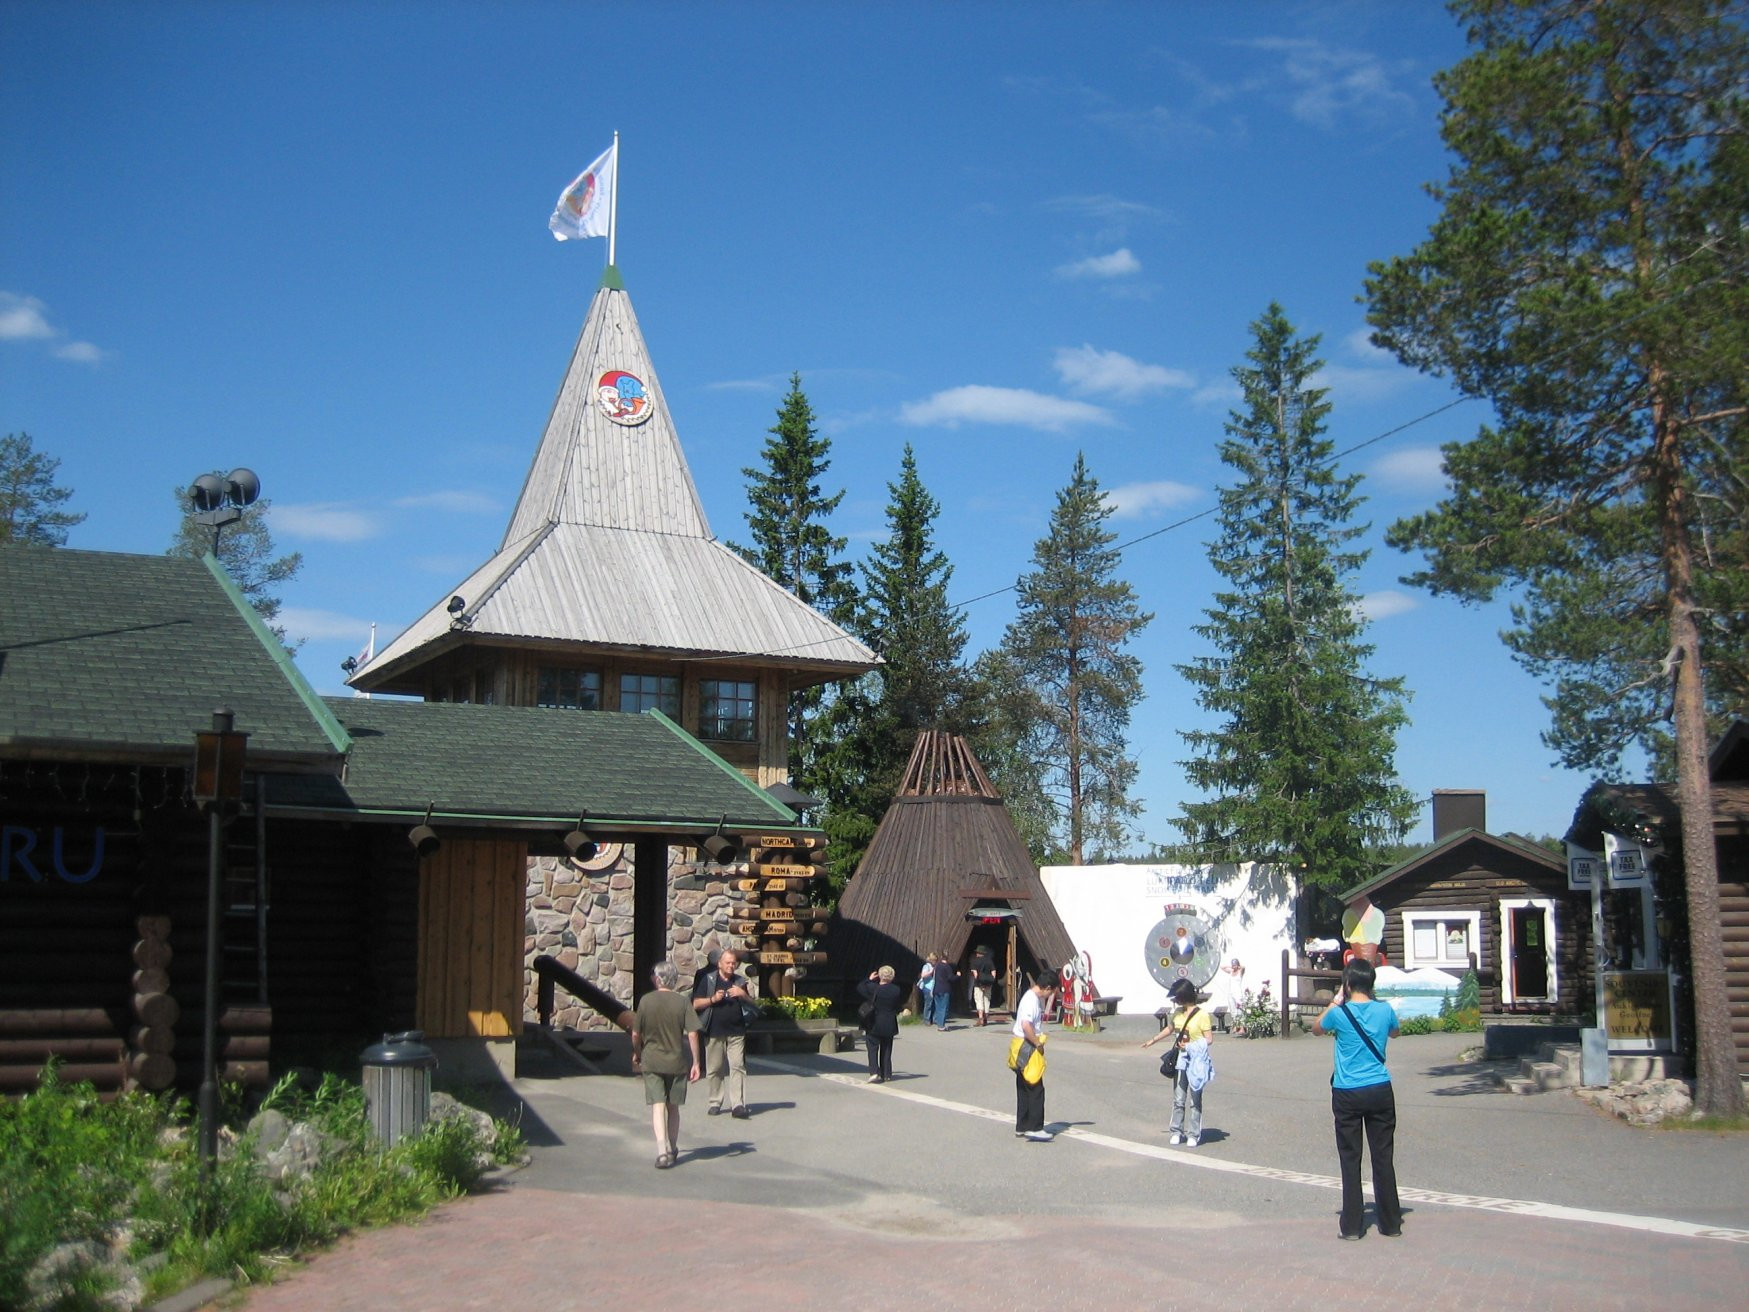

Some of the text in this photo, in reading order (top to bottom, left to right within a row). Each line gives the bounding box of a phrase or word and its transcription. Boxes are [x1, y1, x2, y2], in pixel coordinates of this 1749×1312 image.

[761, 837, 797, 848] NORTHCA
[770, 867, 791, 876] ROMA
[765, 910, 794, 919] MADRID
